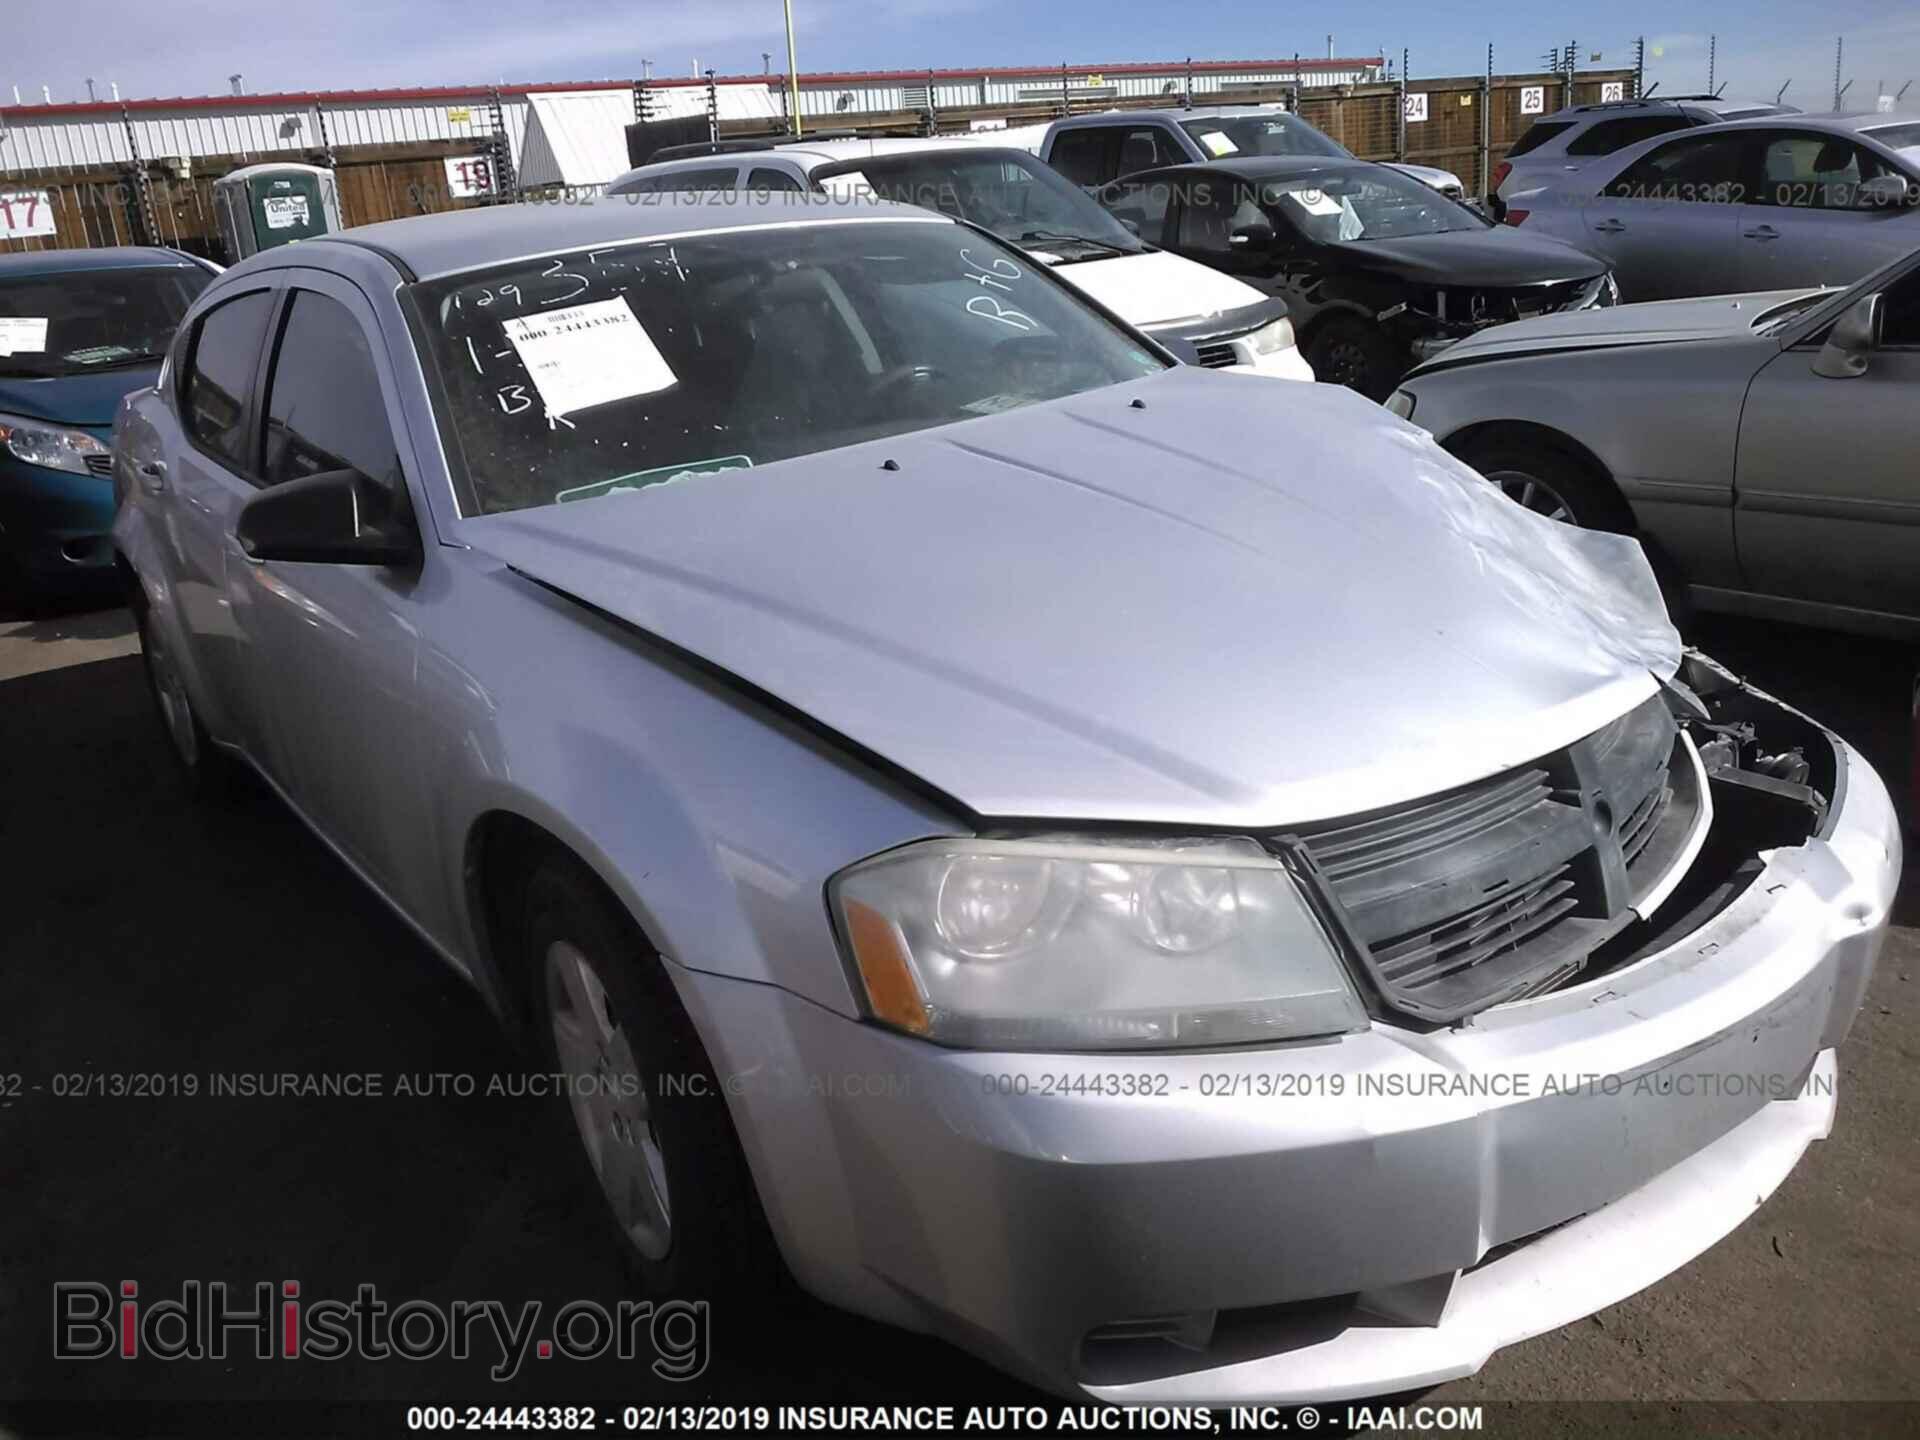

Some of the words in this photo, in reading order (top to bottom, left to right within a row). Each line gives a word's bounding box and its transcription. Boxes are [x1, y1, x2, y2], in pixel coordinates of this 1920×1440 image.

[1524, 91, 1541, 109] 25
[1604, 86, 1620, 101] 26
[1405, 97, 1424, 116] 24
[455, 160, 491, 191] 19
[0, 197, 38, 229] 17
[270, 202, 306, 214] United
